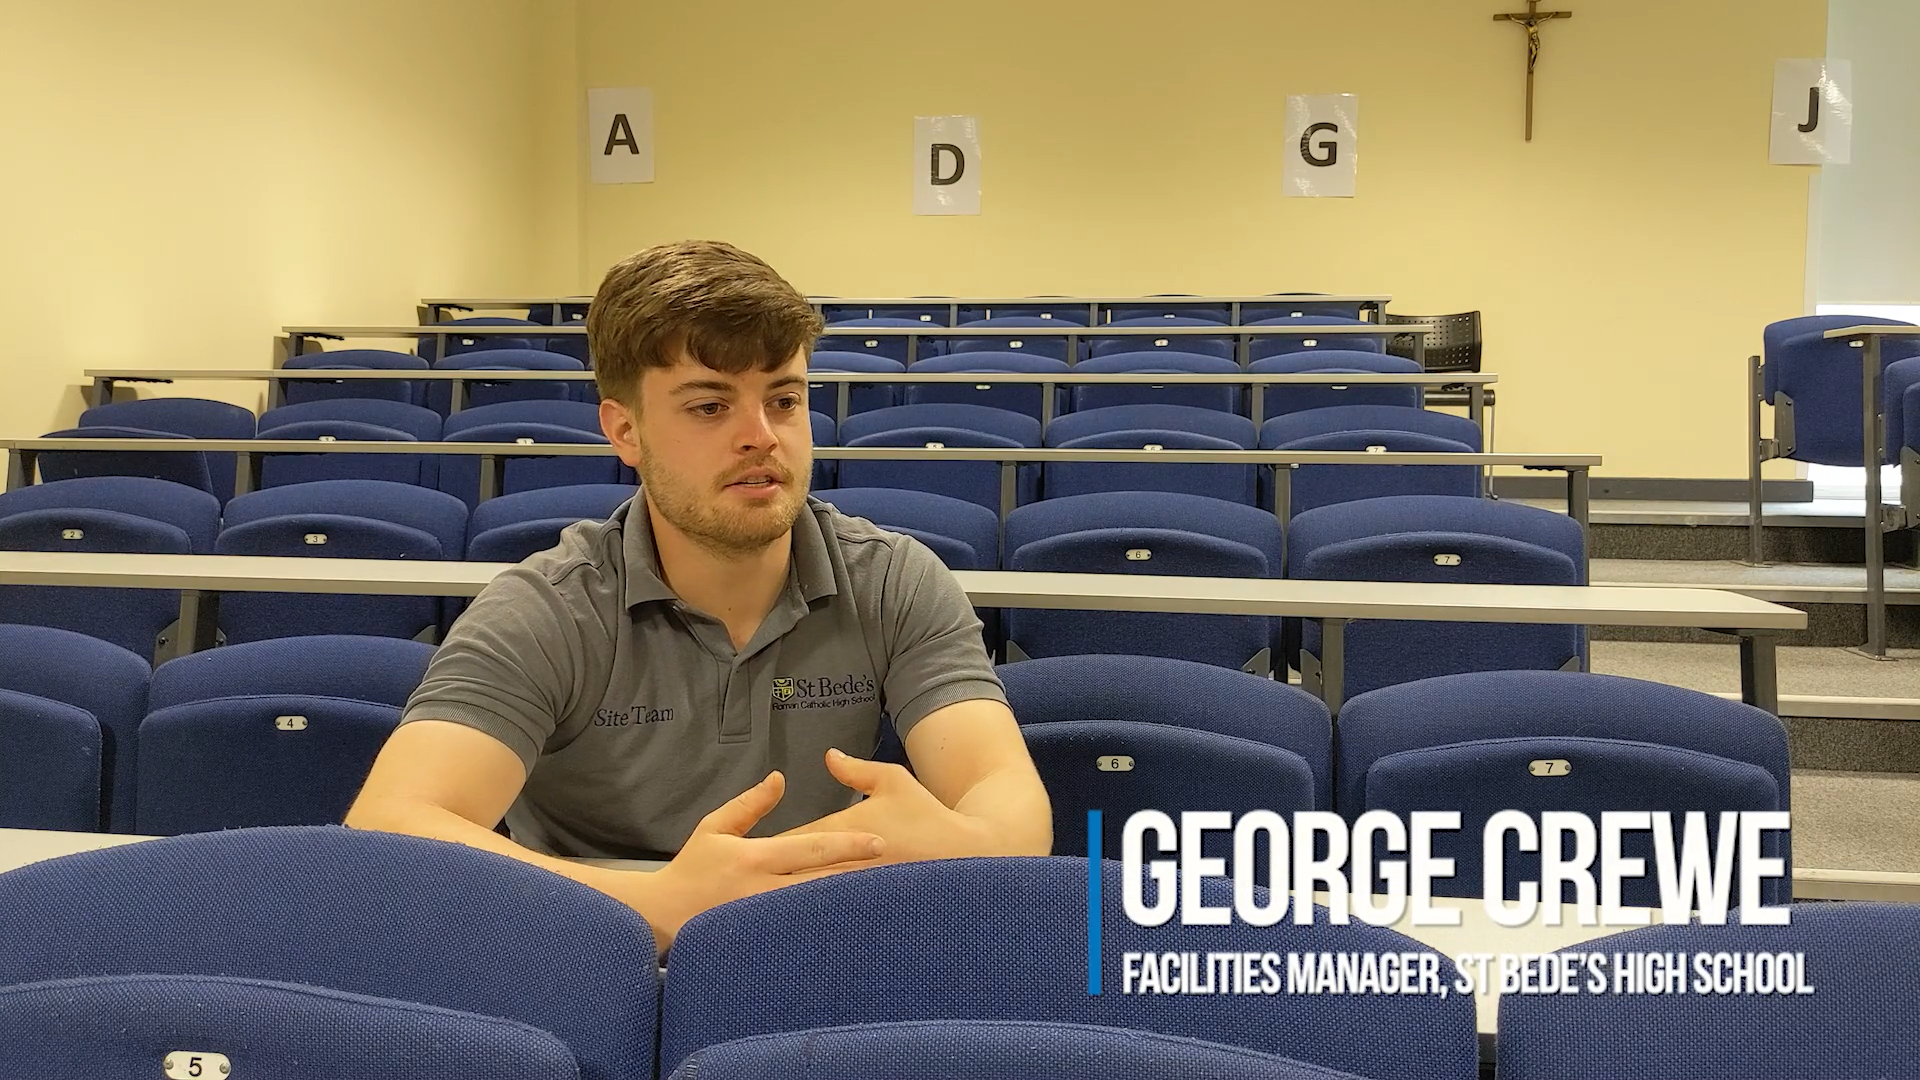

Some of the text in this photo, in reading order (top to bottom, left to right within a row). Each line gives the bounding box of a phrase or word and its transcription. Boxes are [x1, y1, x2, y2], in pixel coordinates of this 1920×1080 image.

[1797, 86, 1820, 133] J
[604, 113, 640, 156] A
[1300, 122, 1339, 167] G
[930, 143, 966, 186] D
[796, 674, 874, 698] St Bede's
[772, 694, 876, 711] Roman Catholic High School
[287, 718, 294, 728] 4
[594, 705, 674, 727] Site Team
[1111, 758, 1119, 769] 6
[1545, 762, 1554, 774] 7
[188, 1057, 203, 1077] 5
